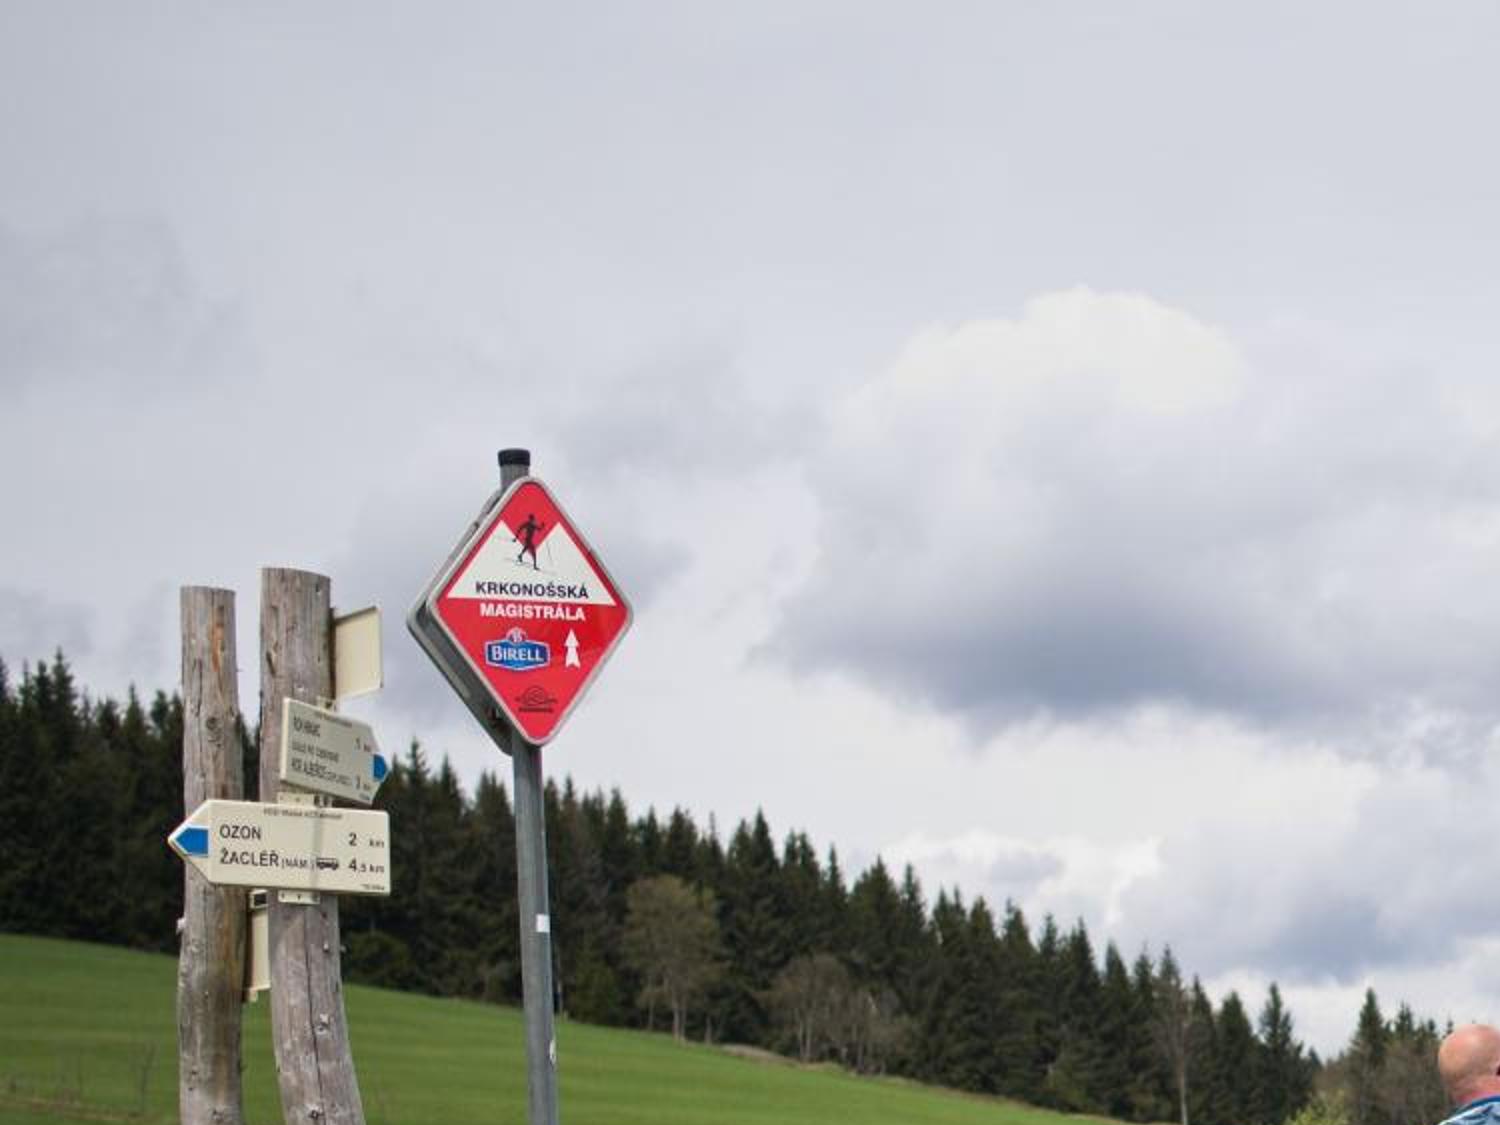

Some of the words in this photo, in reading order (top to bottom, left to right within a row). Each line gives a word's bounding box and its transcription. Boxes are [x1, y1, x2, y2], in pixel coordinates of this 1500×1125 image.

[476, 581, 589, 599] KRKONOŠSKÁ
[480, 602, 586, 621] MAGISTRÁLA
[219, 823, 262, 840] OZON
[348, 831, 358, 847] 2
[220, 847, 279, 867] ŽACLÉŘ
[370, 864, 385, 875] km
